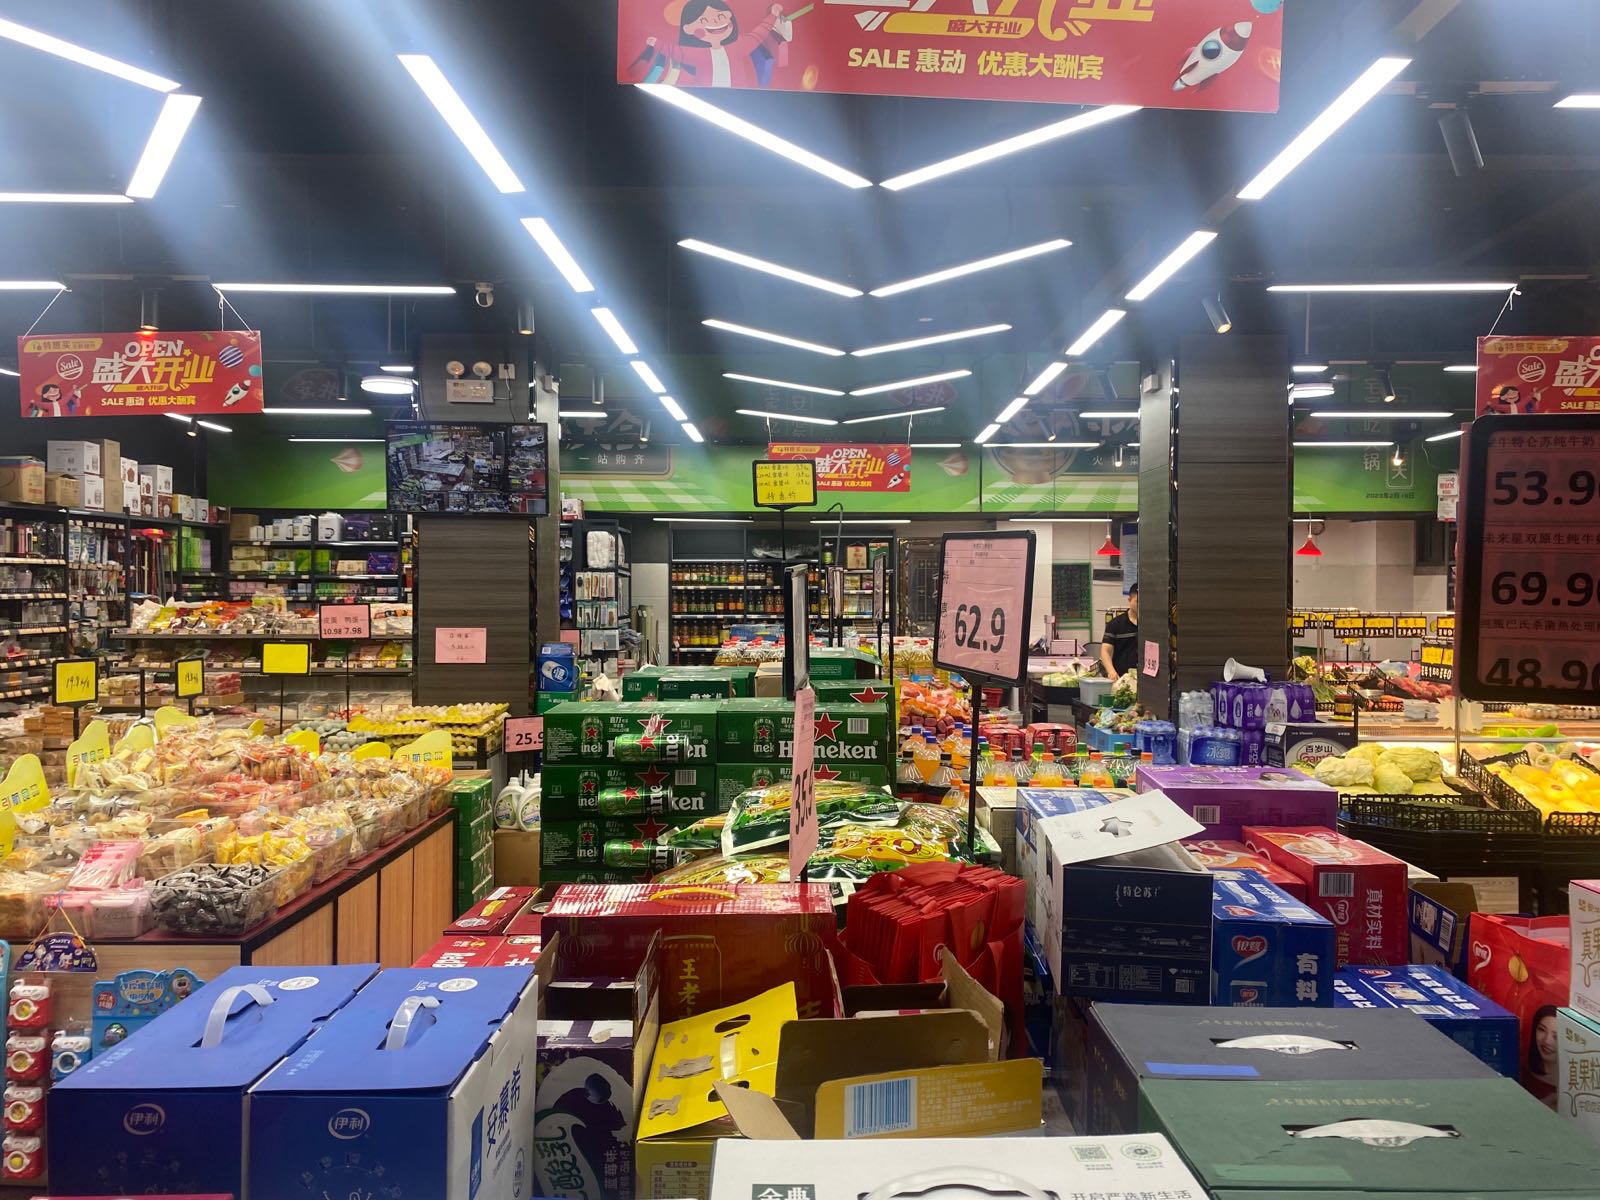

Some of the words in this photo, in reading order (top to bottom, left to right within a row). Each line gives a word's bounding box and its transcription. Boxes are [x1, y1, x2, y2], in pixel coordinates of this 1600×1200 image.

[946, 19, 1022, 36] 盛大开业
[847, 48, 910, 70] SALE
[915, 49, 966, 75] 惠动
[976, 51, 1105, 81] 优惠大酬宾
[124, 339, 185, 358] OPEN
[59, 359, 80, 373] Sale
[90, 352, 217, 392] 盛大开业
[1521, 361, 1542, 374] Sale
[101, 397, 124, 406] SALE
[1560, 401, 1585, 410] SALE
[578, 454, 647, 466] 一站购齐
[832, 448, 868, 459] OPEN
[815, 453, 886, 479] 盛大开业
[1493, 470, 1600, 506] 53.9
[323, 628, 342, 636] 10.98
[344, 627, 362, 635] 7.98
[954, 603, 1006, 654] 62.9
[778, 741, 877, 760] Hneken
[1304, 744, 1334, 754] 百岁山
[1366, 888, 1383, 950] 真材实料
[678, 958, 700, 1018] 王老
[129, 1113, 159, 1126] 伊利
[334, 1116, 364, 1130] 伊利
